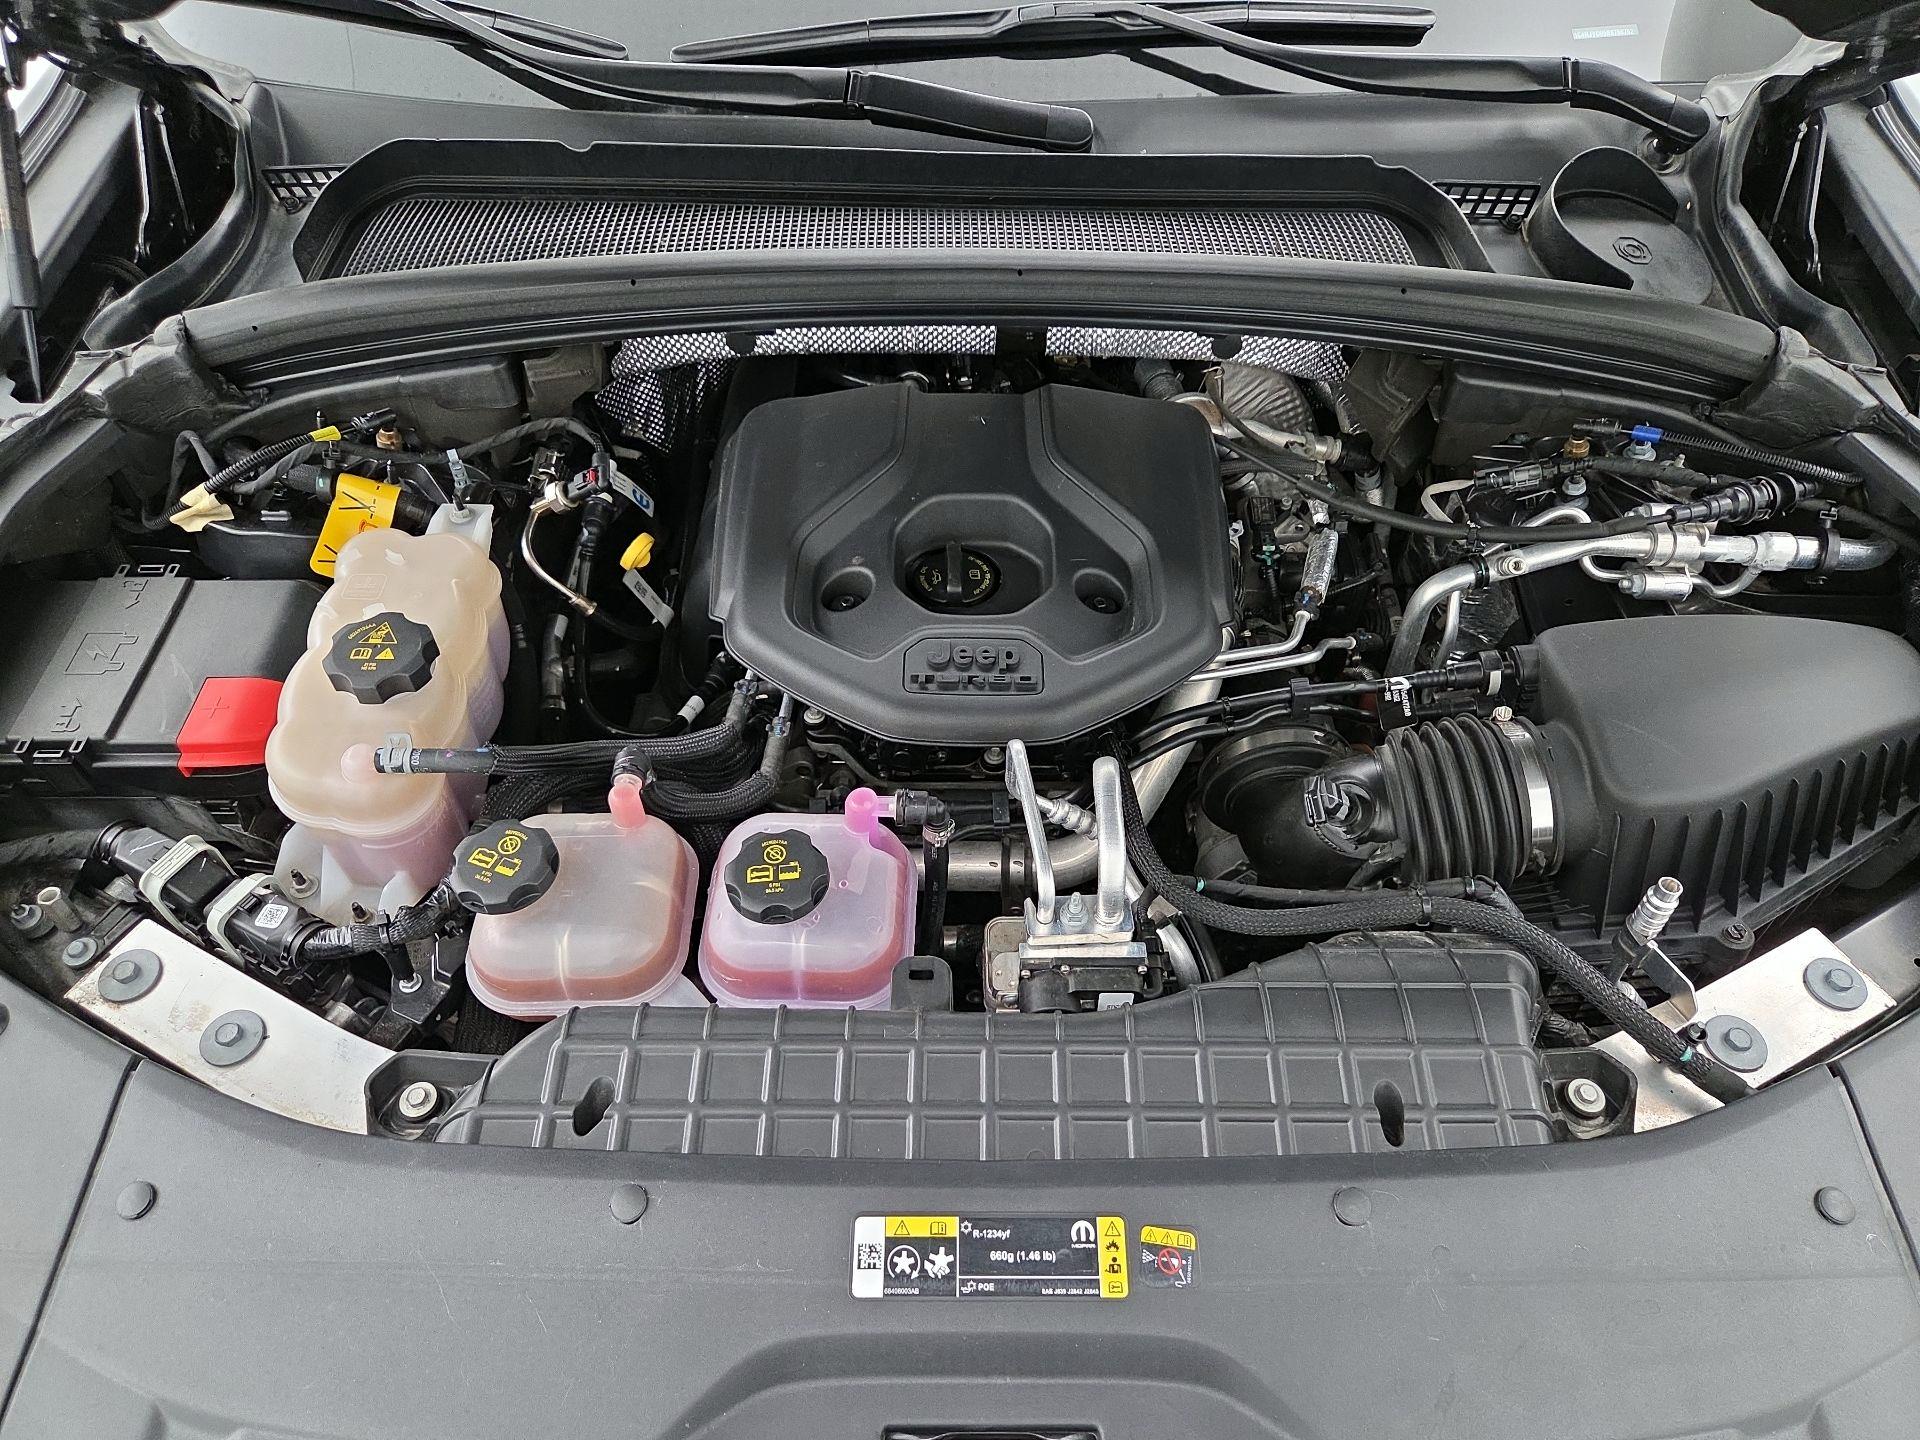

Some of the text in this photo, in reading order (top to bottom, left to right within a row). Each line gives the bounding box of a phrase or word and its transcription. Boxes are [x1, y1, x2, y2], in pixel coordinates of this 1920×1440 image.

[926, 639, 1021, 673] Jeep
[910, 673, 1038, 690] TURBO
[972, 1229, 1011, 1241] R-1234yf
[989, 1250, 1015, 1263] 660g
[1043, 1250, 1057, 1263] lb)
[978, 1282, 995, 1292] POE
